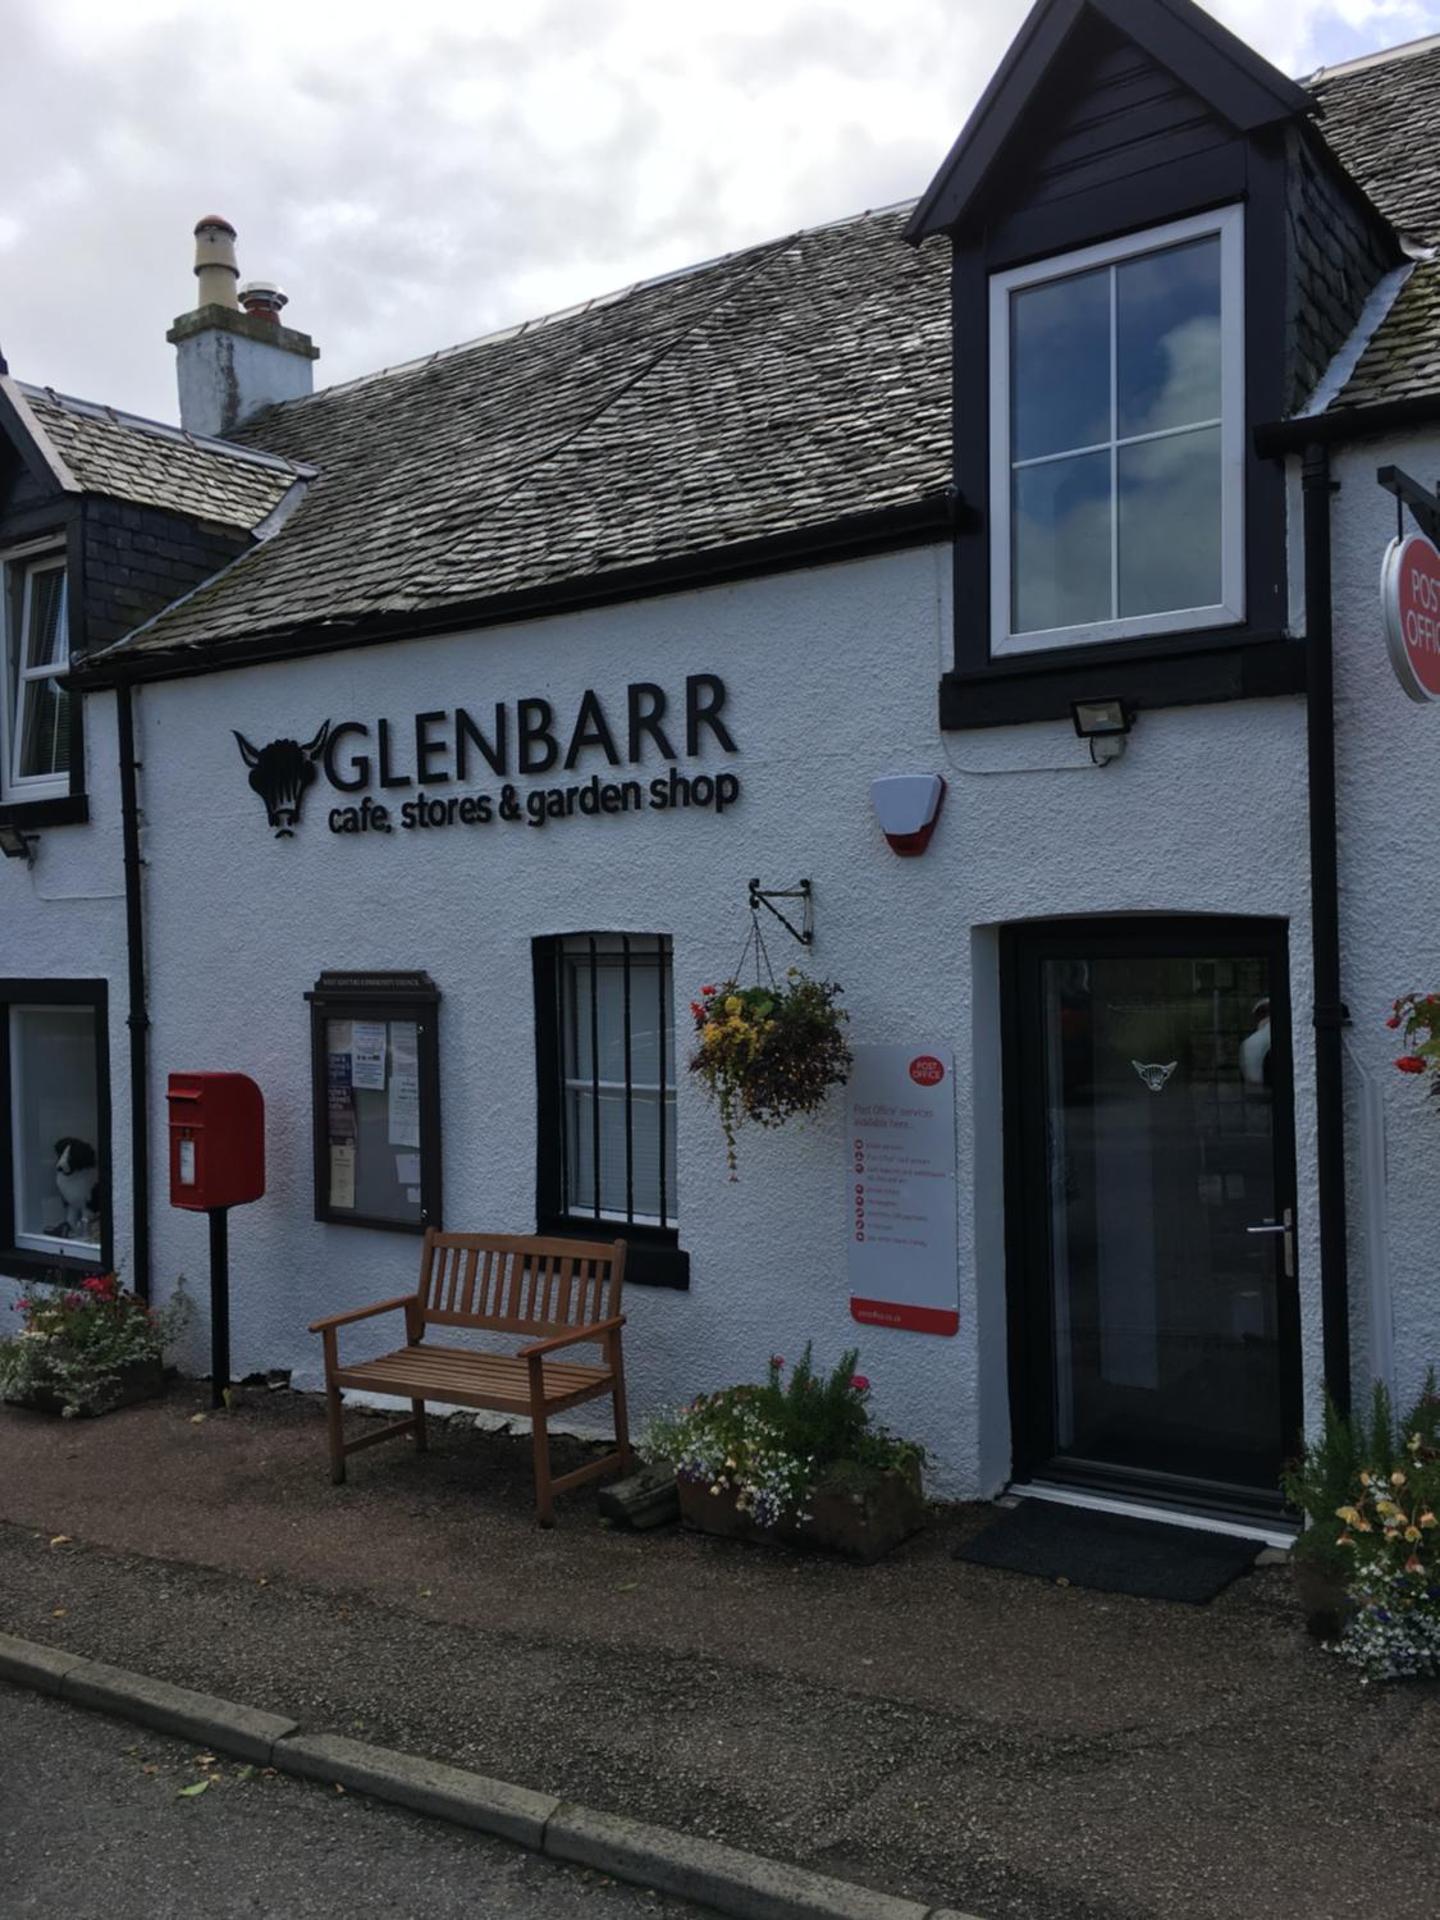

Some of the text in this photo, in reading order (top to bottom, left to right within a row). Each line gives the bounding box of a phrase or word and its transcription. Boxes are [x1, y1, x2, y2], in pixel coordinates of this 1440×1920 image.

[323, 673, 738, 792] GLENBARR
[329, 767, 739, 834] cafe, stores & garden shop
[912, 1069, 941, 1080] OFFICE
[915, 1061, 937, 1070] POST
